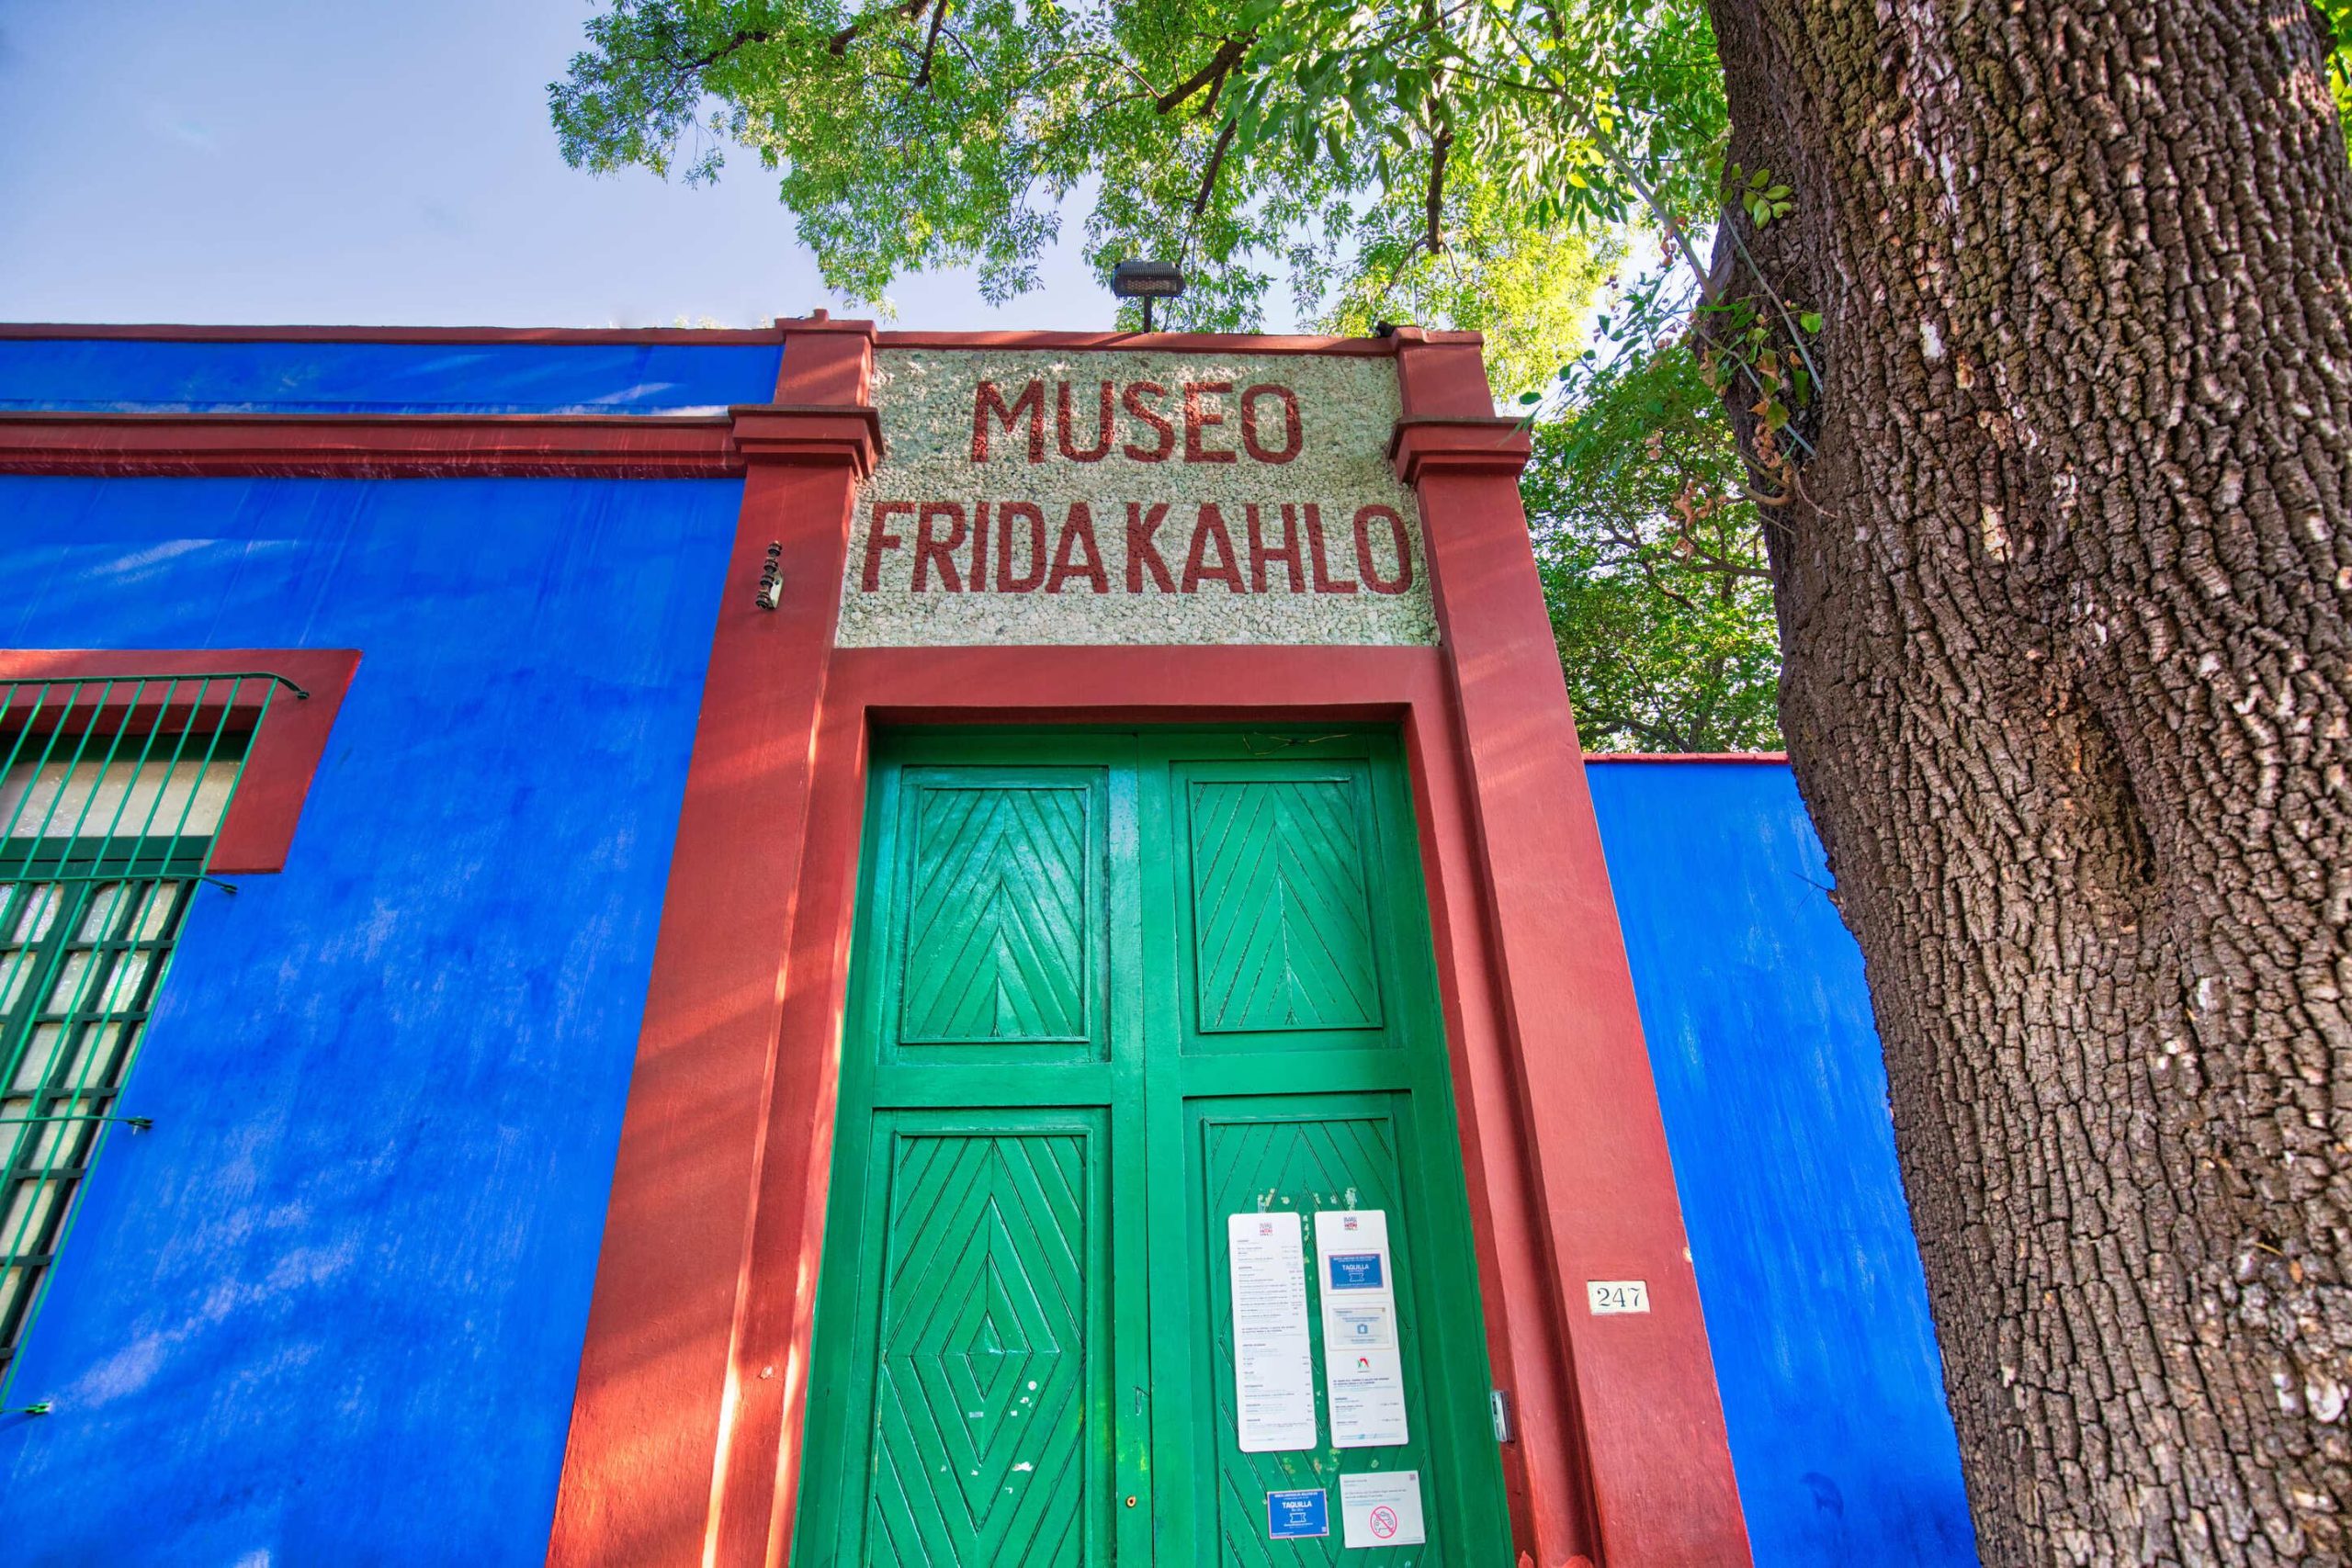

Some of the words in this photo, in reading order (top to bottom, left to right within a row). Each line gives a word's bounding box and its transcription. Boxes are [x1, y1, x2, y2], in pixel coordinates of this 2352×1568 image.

[971, 380, 1303, 464] MUSEO
[861, 501, 1109, 594] FRIDA
[1125, 502, 1413, 594] KAHLO
[1341, 1263, 1369, 1271] TAQUILLA
[1597, 1287, 1641, 1307] 247
[1282, 1500, 1312, 1509] TAQUILLA
